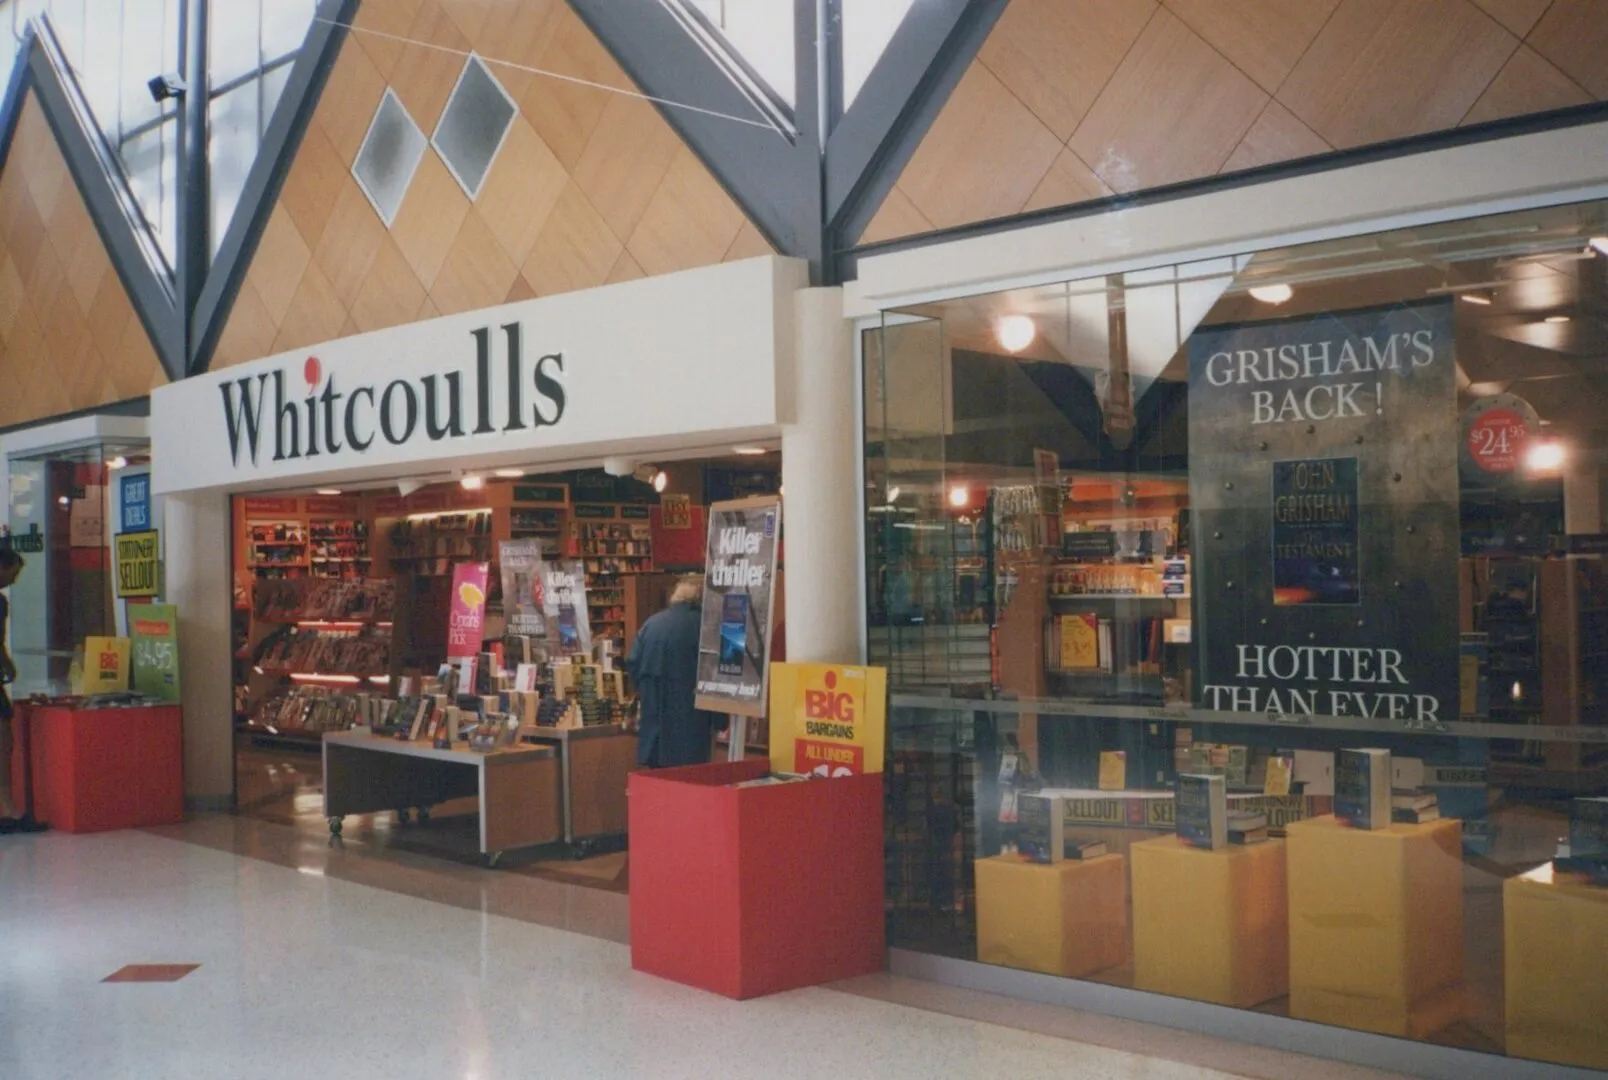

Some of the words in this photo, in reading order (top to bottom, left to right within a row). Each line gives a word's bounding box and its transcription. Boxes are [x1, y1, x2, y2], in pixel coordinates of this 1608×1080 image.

[1206, 330, 1434, 386] GRISHAM'S
[219, 322, 566, 468] Whitcoulls
[125, 505, 146, 527] DEALS
[1276, 493, 1350, 522] GRISHAM
[720, 526, 764, 554] Killer
[120, 560, 154, 590] SELLOUT
[712, 558, 766, 587] thriller
[1235, 644, 1409, 684] HOTTER
[805, 689, 855, 722] BIG
[1203, 685, 1319, 718] THAN
[1328, 690, 1446, 730] EVER
[806, 720, 854, 740] BARGAINS
[805, 744, 820, 759] ALL
[824, 746, 855, 764] UNDER
[1065, 799, 1118, 819] SELLOUT
